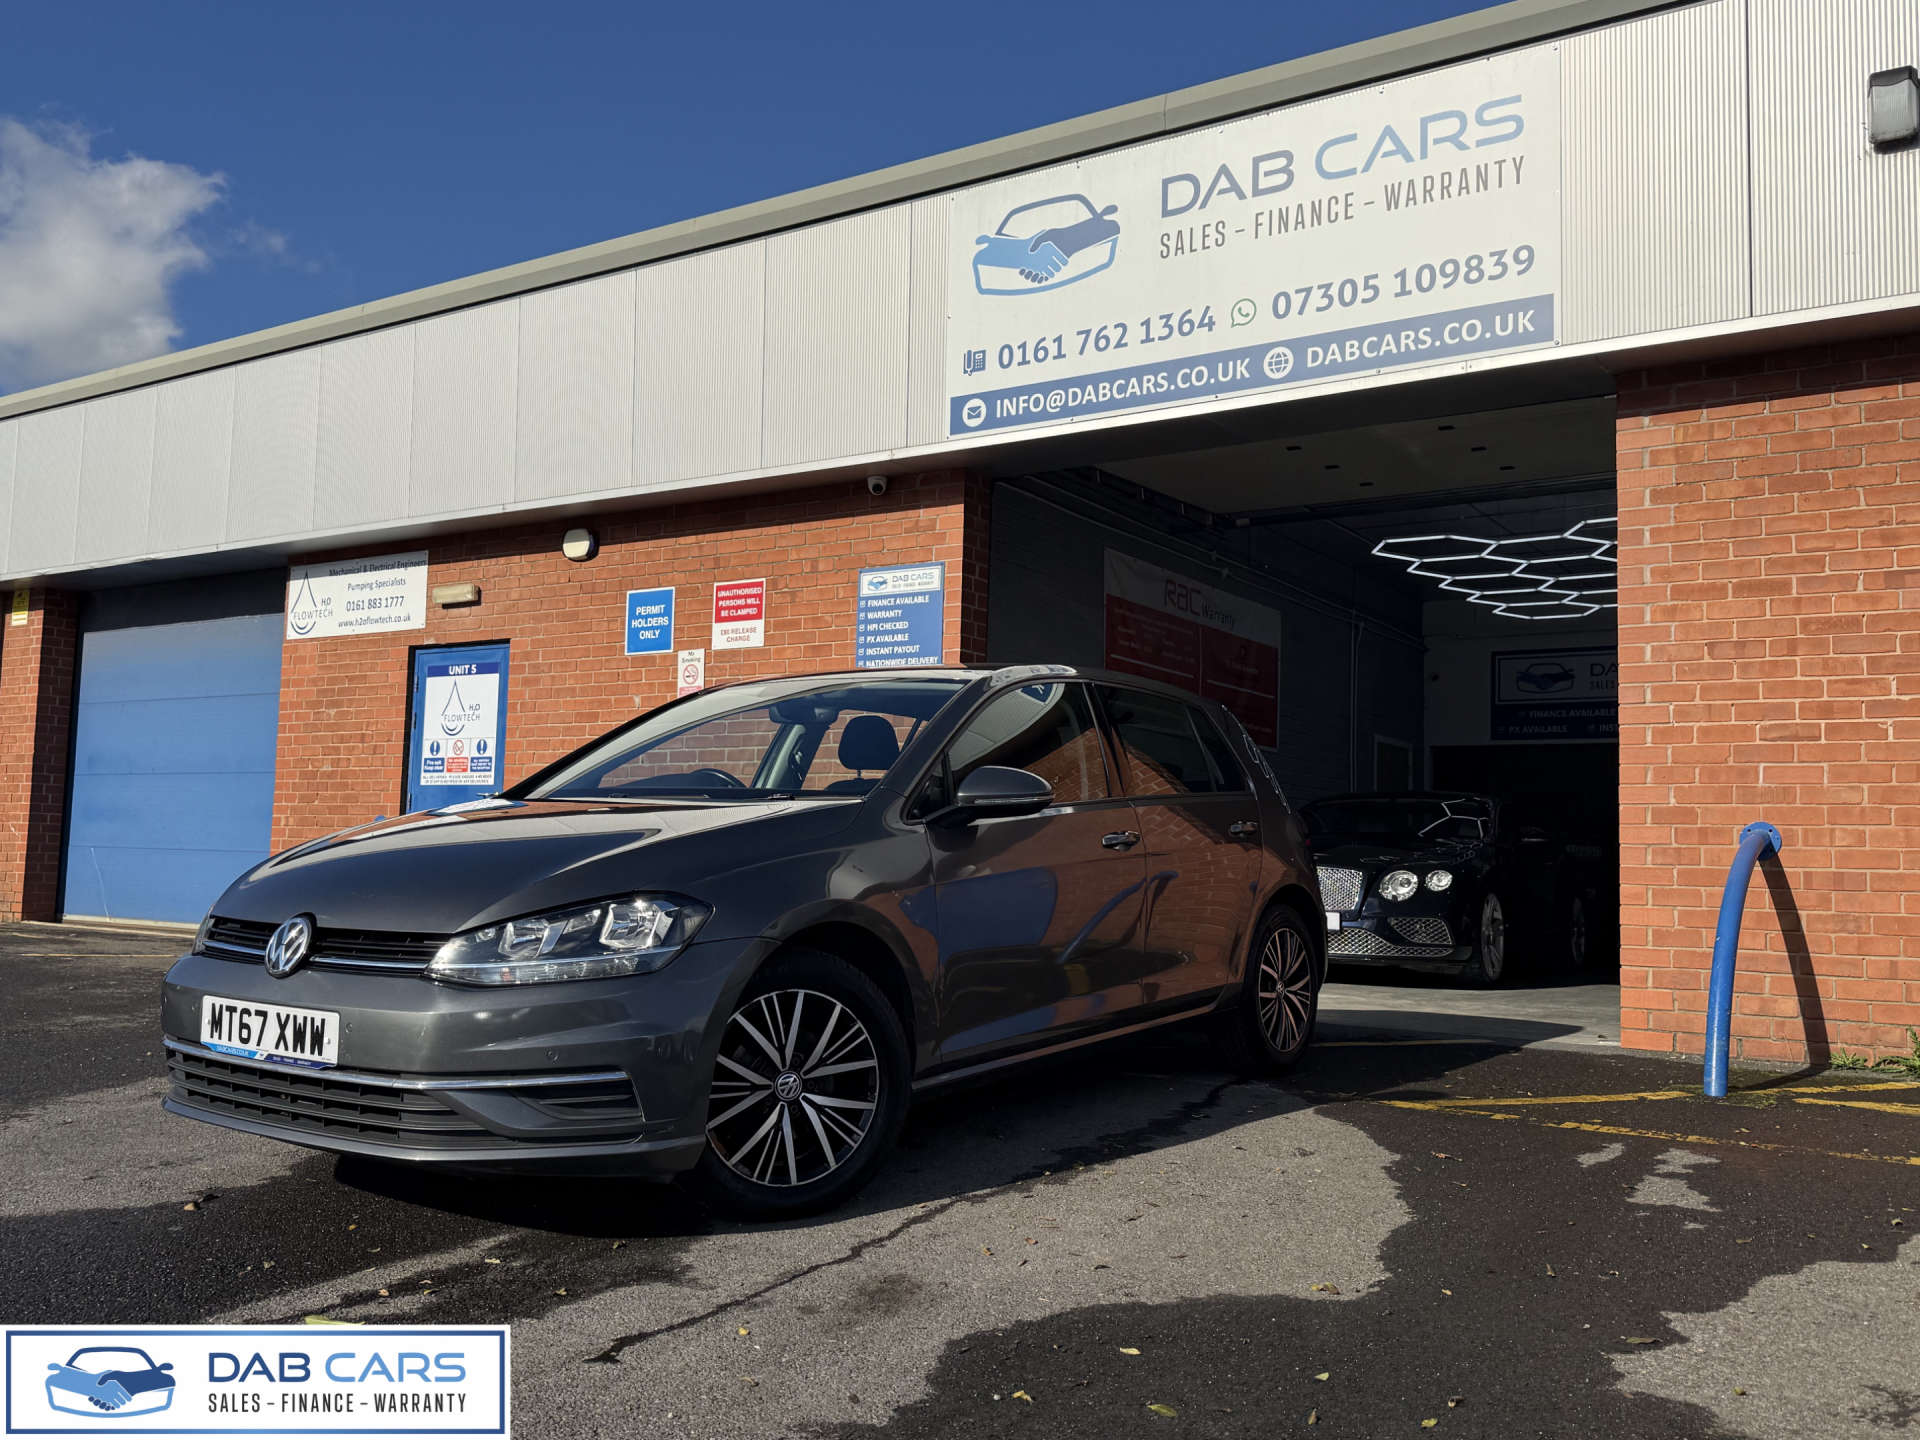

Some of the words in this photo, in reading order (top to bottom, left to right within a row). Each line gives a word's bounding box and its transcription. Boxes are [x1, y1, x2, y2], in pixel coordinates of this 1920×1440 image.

[1161, 150, 1294, 218] DAB
[1315, 94, 1524, 180] CARS
[1160, 219, 1226, 259] SALES
[1254, 191, 1355, 239] FINANCE
[1384, 156, 1525, 211] WARRANTY
[1272, 273, 1380, 319] 07305
[1393, 244, 1535, 299] 109839
[998, 336, 1065, 369] 0161
[1076, 322, 1128, 355] 762
[1139, 305, 1216, 344] 1364
[1306, 309, 1535, 368] DABCARS.CO.UK
[996, 357, 1251, 419] INFO@DABCARS.CO.UK
[348, 582, 373, 591] Pumping
[375, 578, 406, 589] Specialists
[718, 587, 762, 597] UNAUTHORISED
[346, 600, 365, 612] 0161
[367, 598, 382, 610] 883
[385, 596, 405, 608] 1777
[719, 599, 745, 607] PERSONS
[746, 597, 760, 605] WILL
[868, 598, 894, 607] FINANCE
[896, 595, 929, 605] AVAILABLE
[294, 608, 333, 620] FLOWTECH
[636, 604, 665, 615] PERMIT
[730, 608, 758, 616] CLAMPED
[867, 610, 902, 619] WARRANTY
[338, 612, 411, 628] www.h2oflowtech.co.uk
[631, 617, 669, 628] HOLDERS
[731, 627, 757, 635] RELEASE
[867, 623, 878, 631] HPI
[879, 621, 909, 631] CHECKED
[640, 630, 660, 639] ONLY
[727, 635, 750, 643] CHARGE
[867, 635, 875, 643] PX
[876, 633, 909, 642] AVAILABLE
[866, 647, 893, 655] INSTANT
[894, 645, 920, 654] PAYOUT
[908, 656, 938, 665] DELIVERY
[449, 665, 469, 675] UNIT
[471, 664, 477, 674] 5
[1590, 663, 1617, 676] DA
[444, 713, 480, 722] FLOWTECH
[1599, 723, 1617, 734] INST
[210, 1003, 268, 1046] MT67
[275, 1012, 326, 1056] XWW
